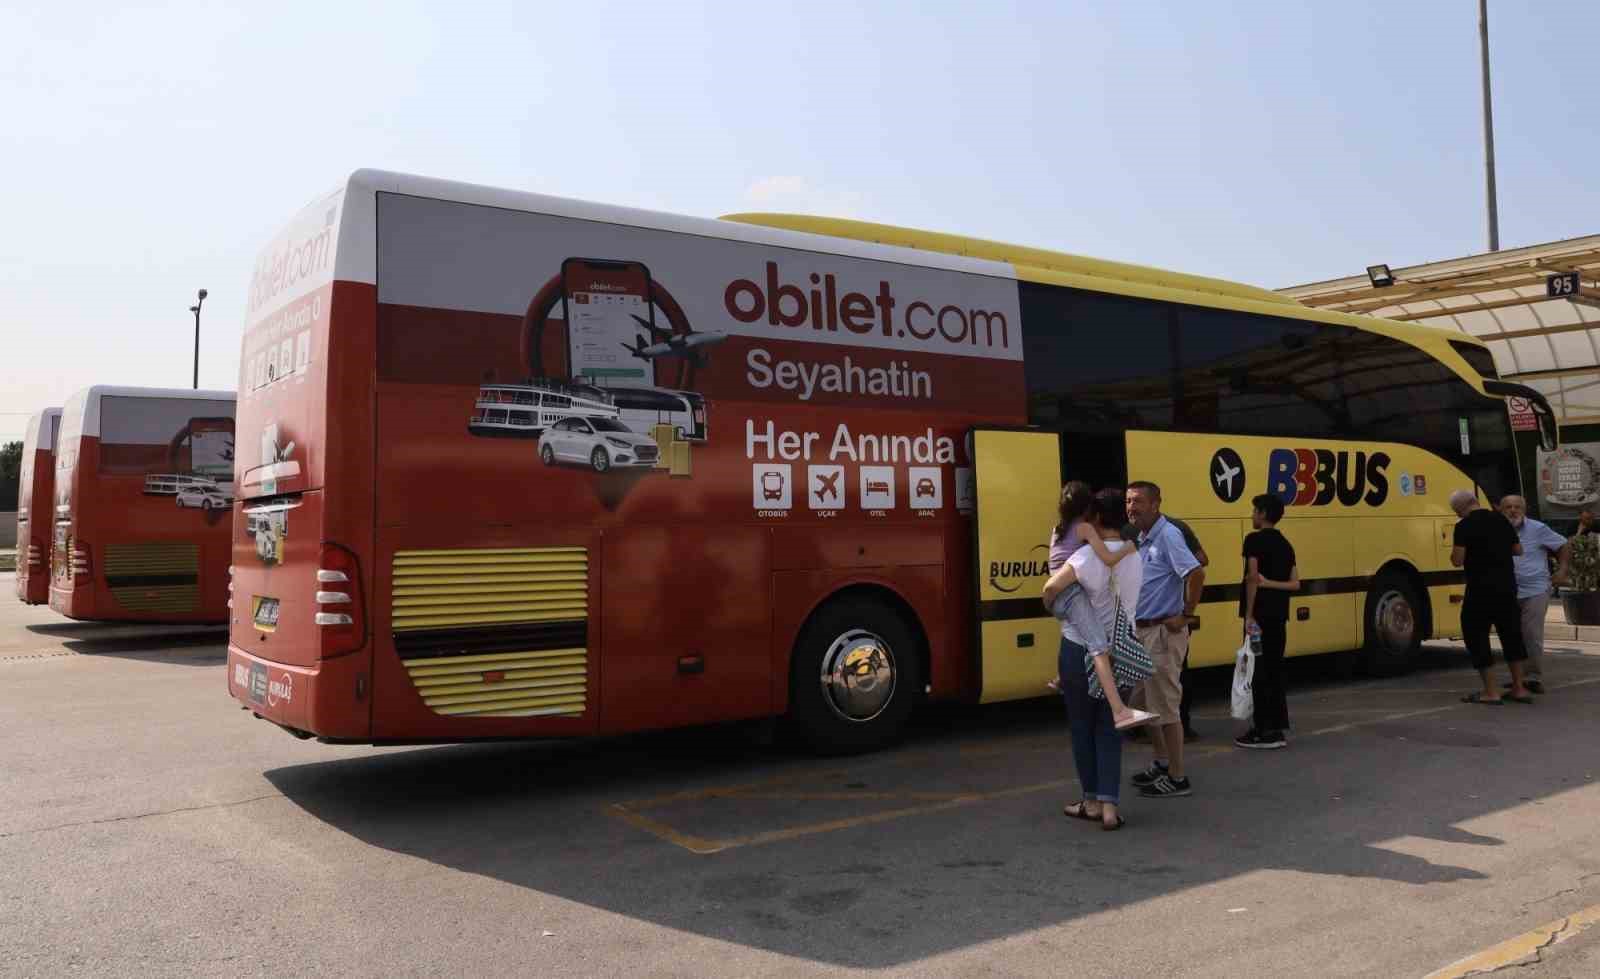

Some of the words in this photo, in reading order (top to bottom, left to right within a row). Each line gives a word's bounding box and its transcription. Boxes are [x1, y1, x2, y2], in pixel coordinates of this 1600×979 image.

[724, 261, 1008, 348] obilet.com
[1553, 276, 1572, 294] 95
[747, 349, 932, 400] Seyahatin
[746, 419, 820, 461] Her
[829, 423, 955, 464] Anında
[1267, 448, 1391, 507] BBBUS
[990, 561, 1050, 577] BURULA
